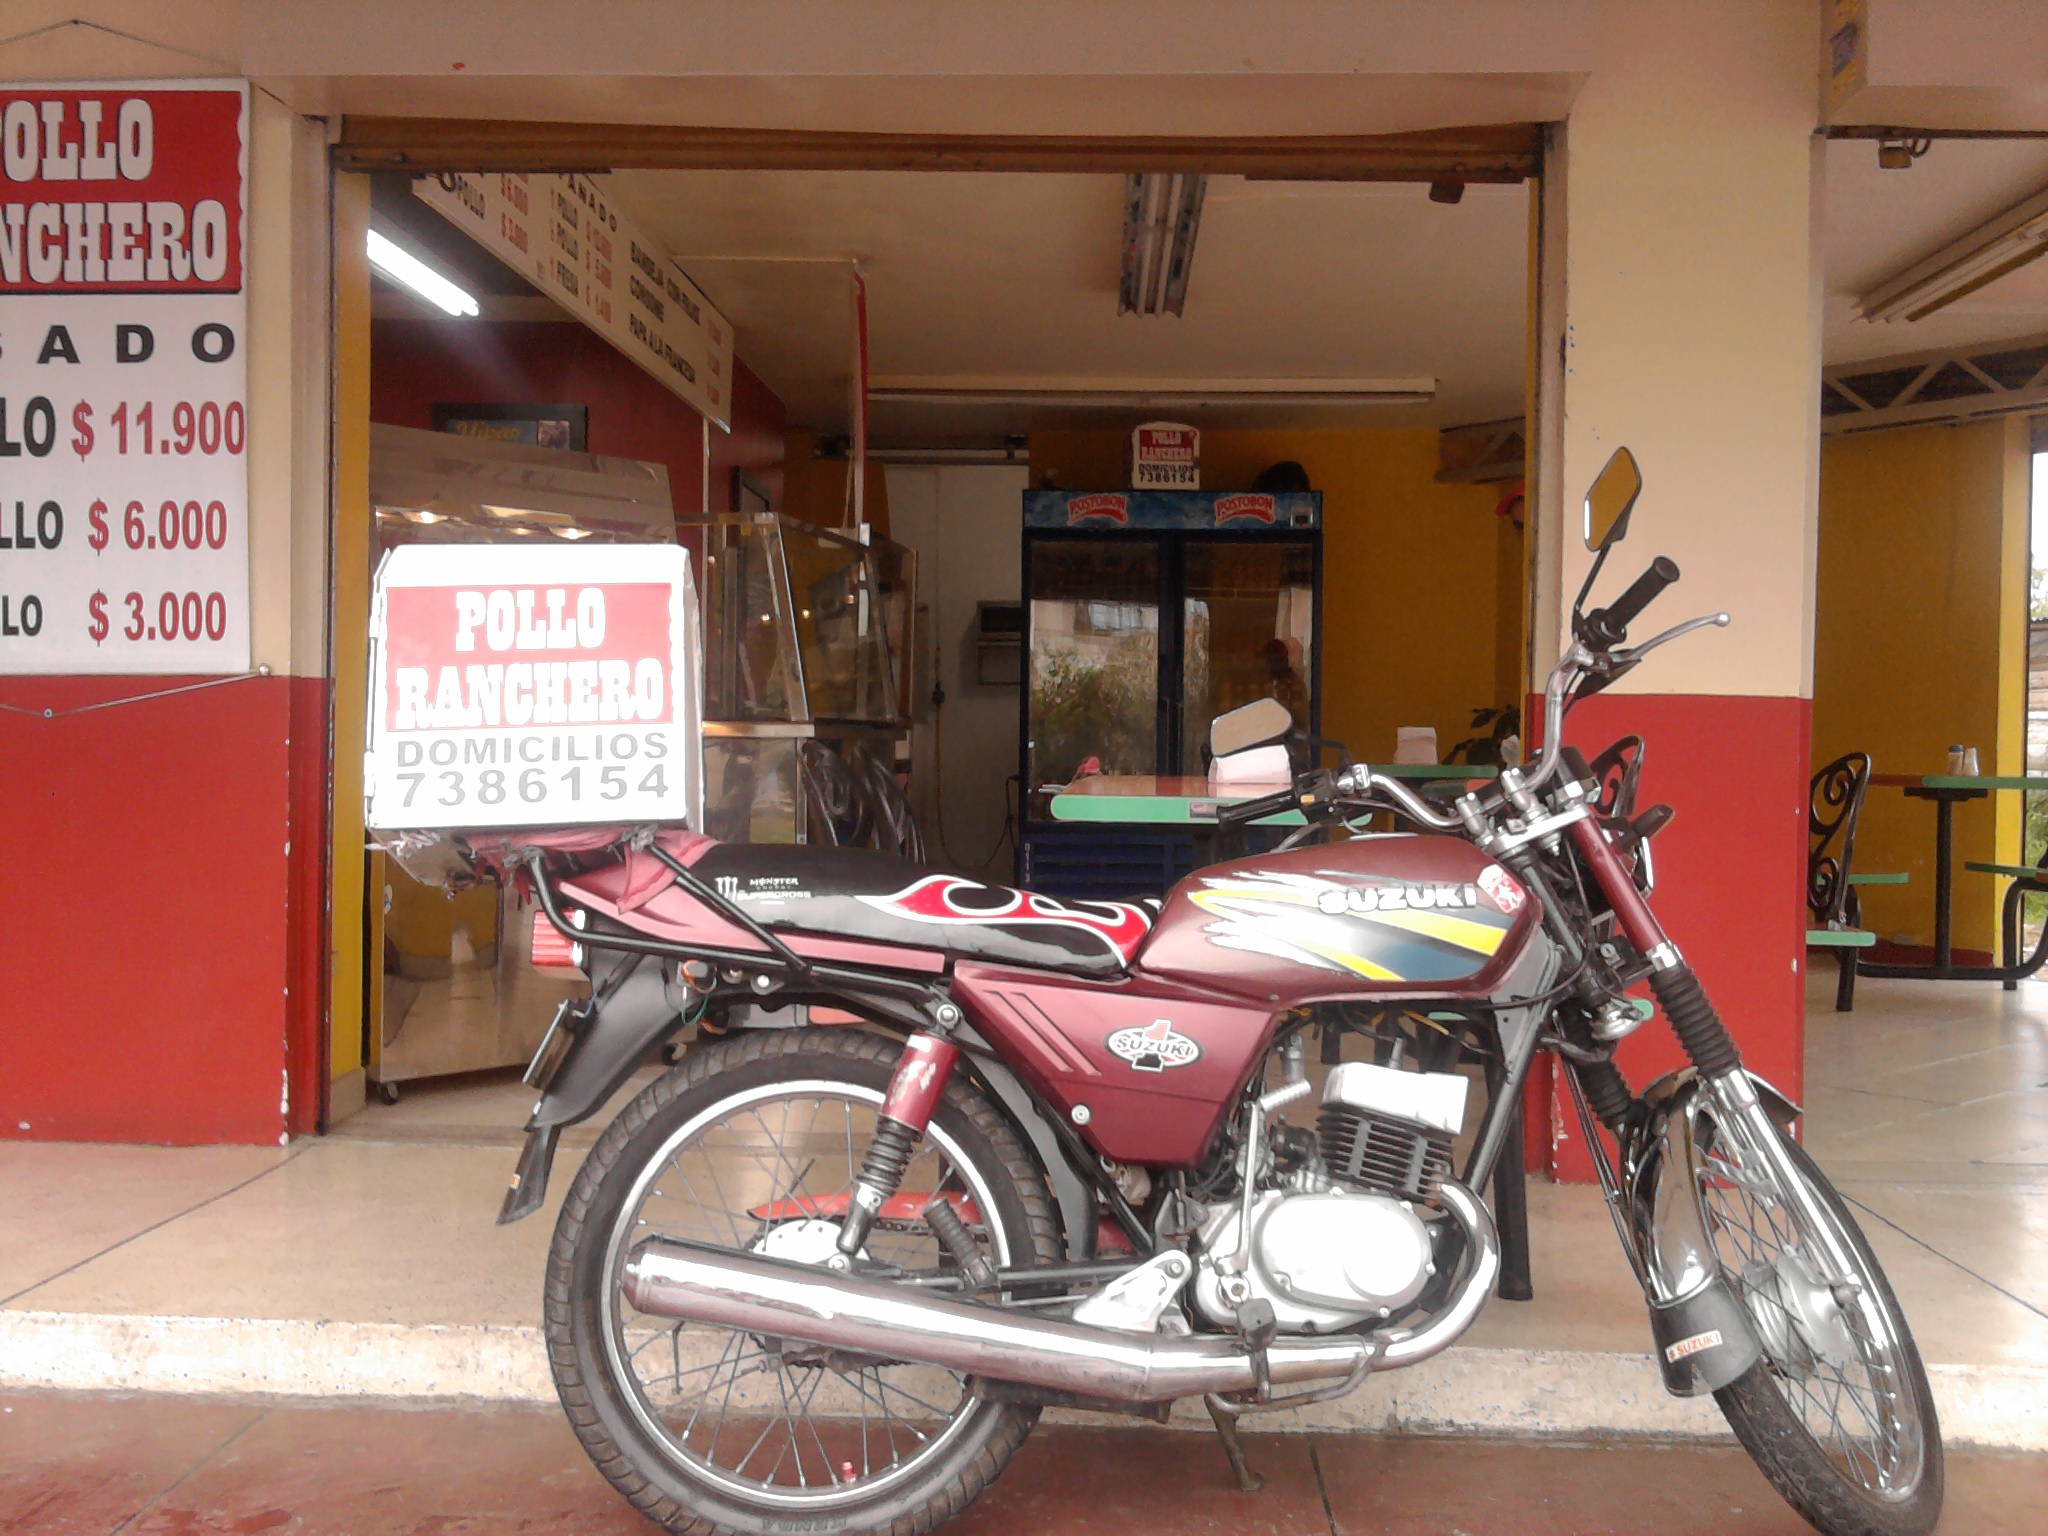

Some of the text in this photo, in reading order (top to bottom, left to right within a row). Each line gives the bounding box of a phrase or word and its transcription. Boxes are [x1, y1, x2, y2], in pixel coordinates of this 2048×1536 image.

[0, 98, 154, 182] OLLO
[0, 323, 236, 364] ADO
[111, 401, 245, 455] 11.900
[124, 500, 228, 550] 6.000
[123, 591, 227, 641] 3.000
[455, 587, 606, 652] POLLO
[395, 657, 664, 730] RANCHERO
[397, 732, 668, 767] DOMICILIOS
[396, 764, 668, 807] 7386154
[1318, 883, 1478, 915] SUZUKI
[1116, 1033, 1194, 1056] SUZUKI
[1677, 1332, 1720, 1356] SUZUKI
